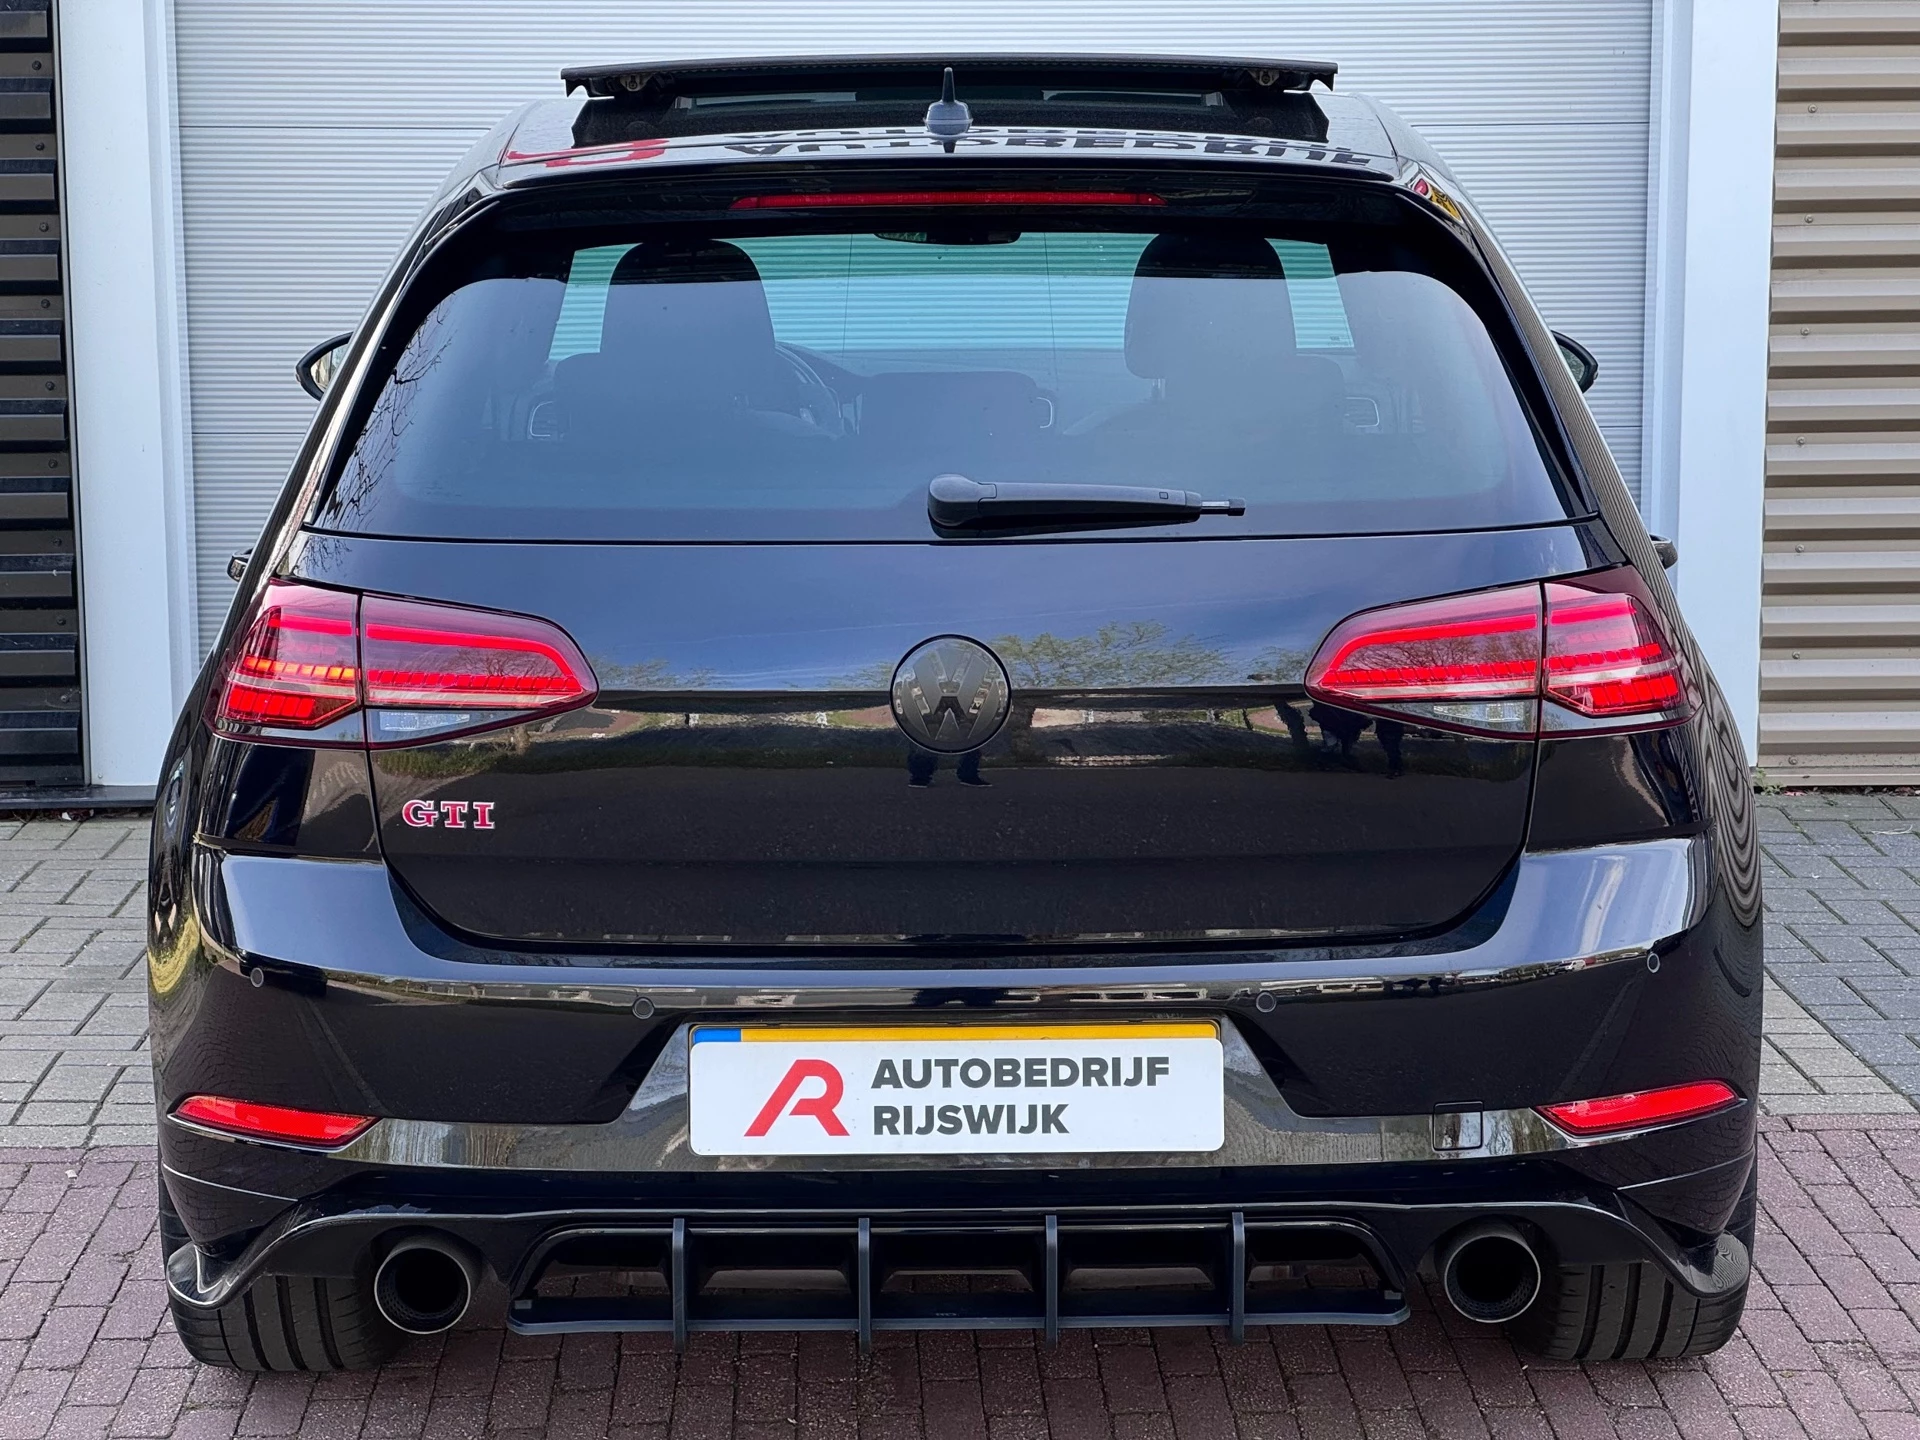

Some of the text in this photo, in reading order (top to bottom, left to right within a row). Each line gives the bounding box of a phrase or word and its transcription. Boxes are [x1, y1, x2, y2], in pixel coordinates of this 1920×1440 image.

[402, 800, 495, 829] GTI
[871, 1057, 1169, 1089] AUTOBEDRIJF
[873, 1104, 1069, 1135] RIJSWIJK
